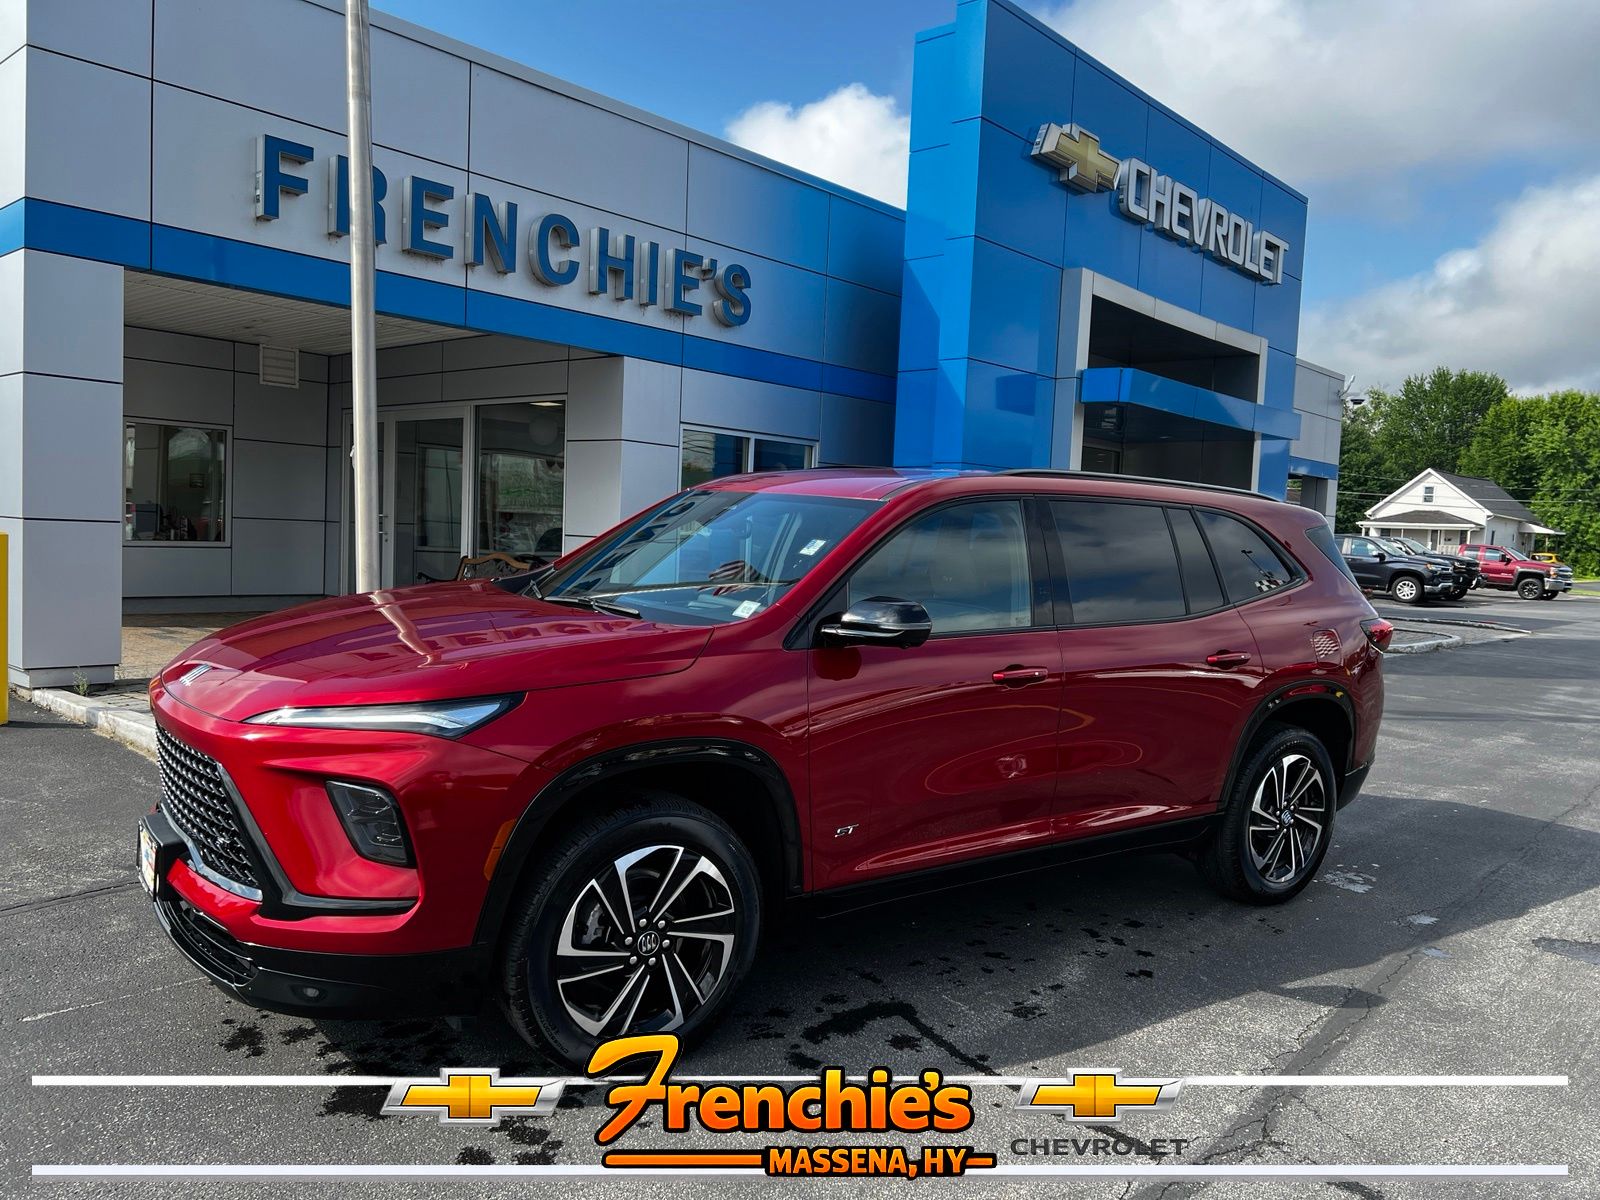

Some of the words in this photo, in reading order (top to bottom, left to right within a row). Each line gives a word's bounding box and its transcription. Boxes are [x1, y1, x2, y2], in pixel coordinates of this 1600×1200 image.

[255, 133, 753, 327] FRENCHIE'S
[1119, 157, 1290, 286] CHEVROLET
[834, 823, 860, 838] ST
